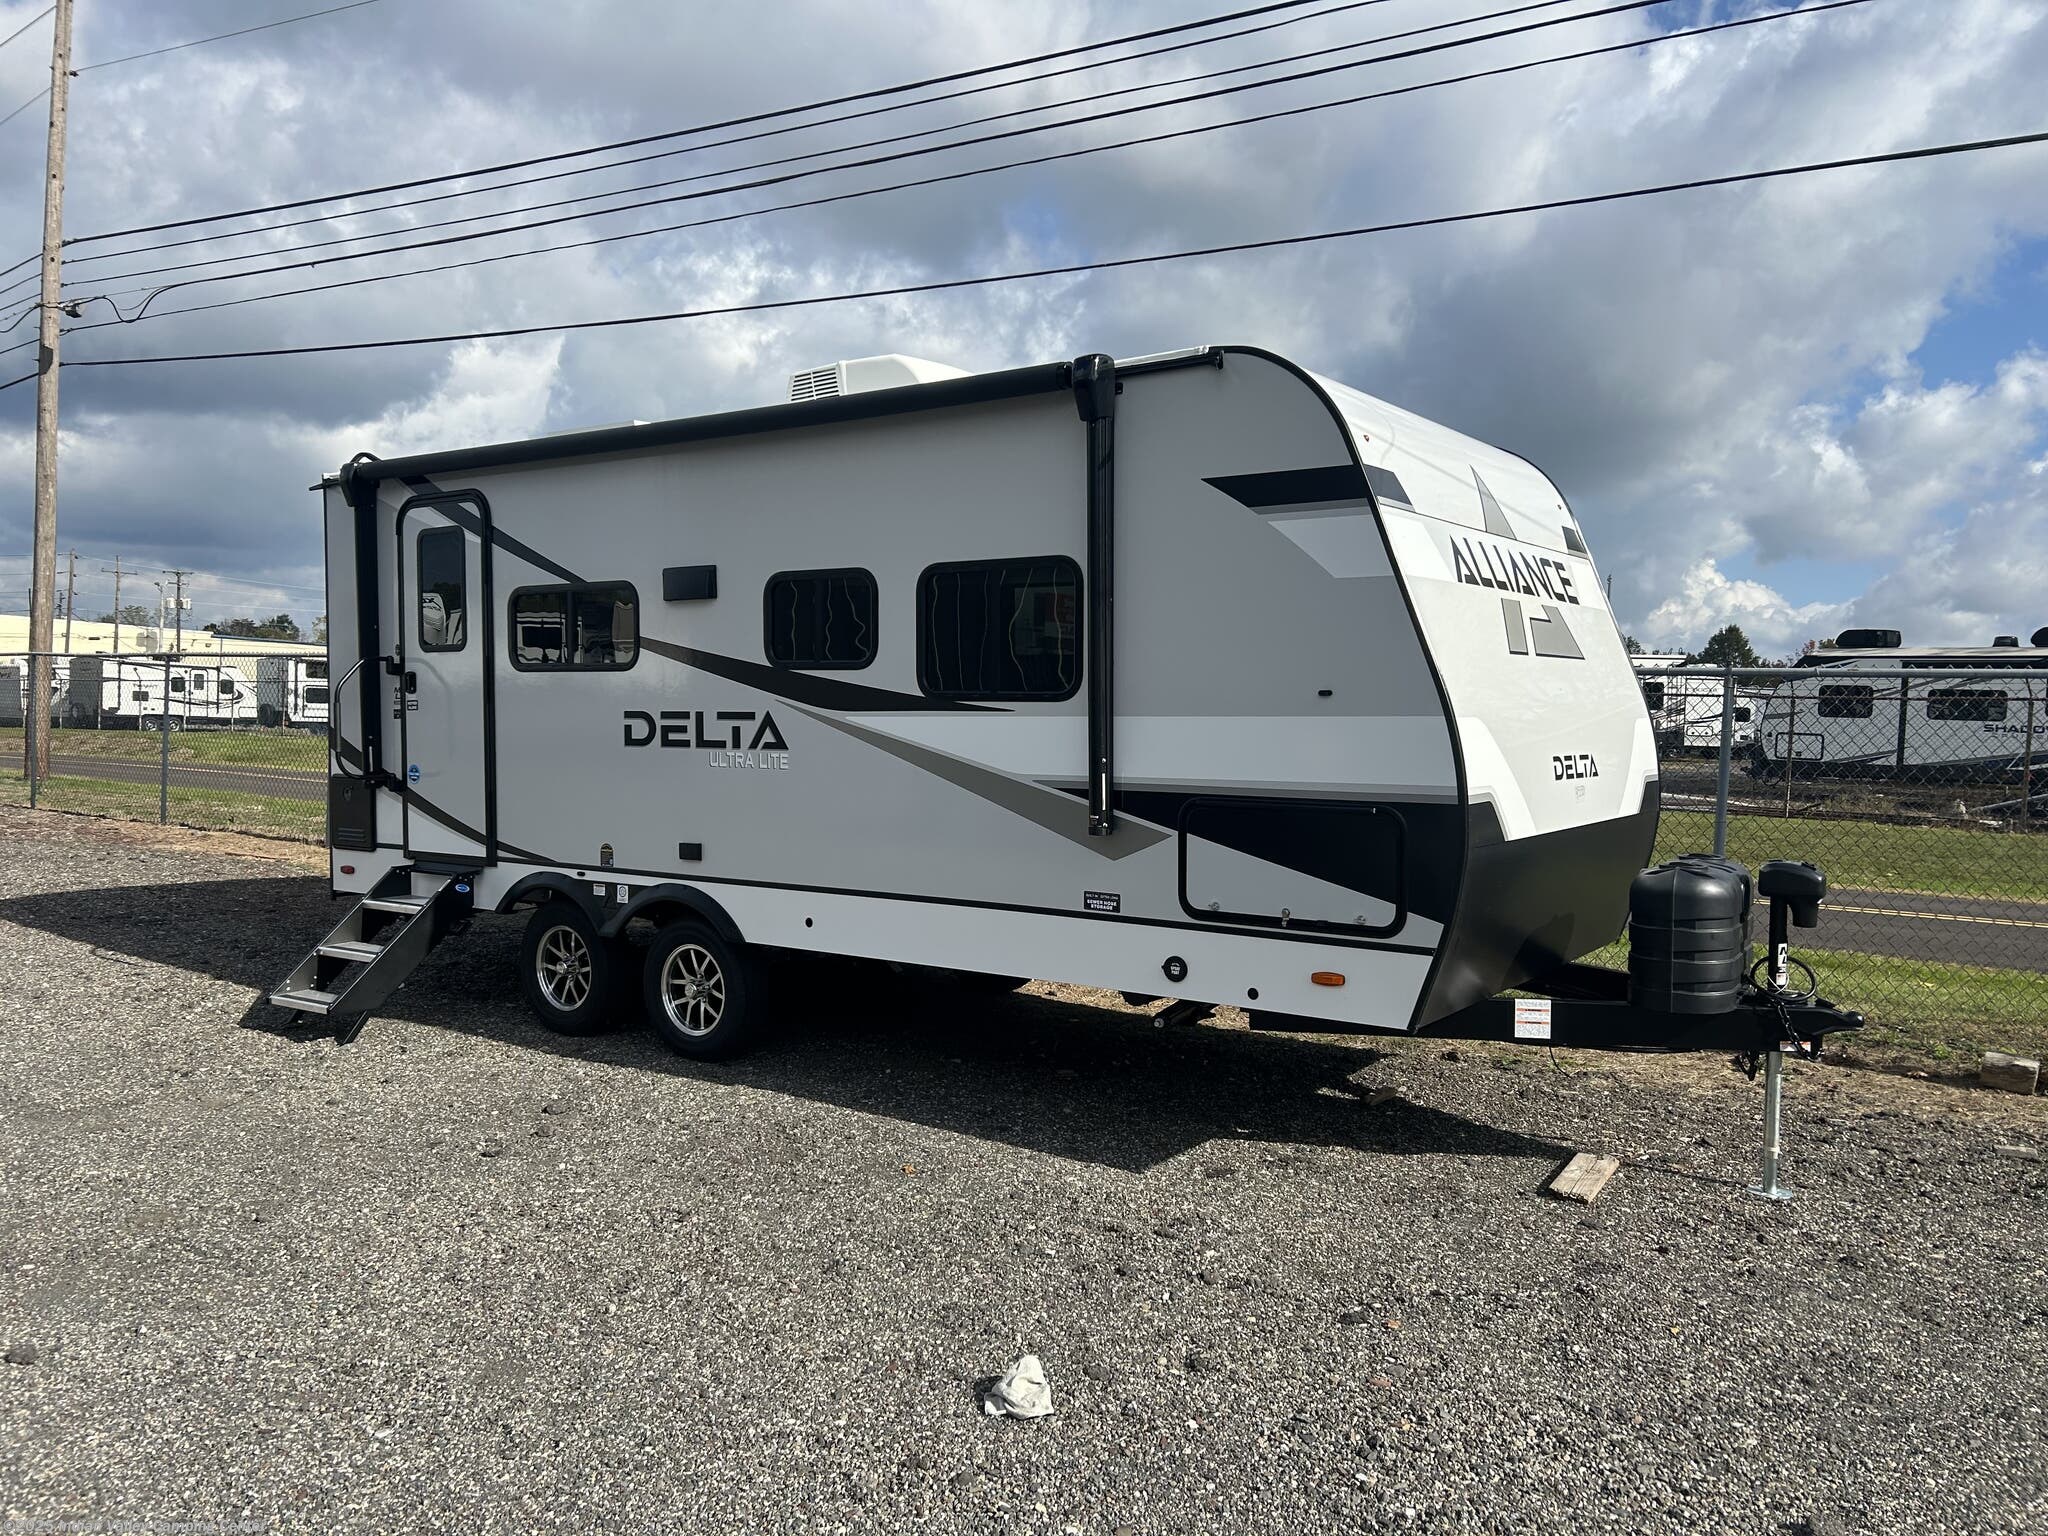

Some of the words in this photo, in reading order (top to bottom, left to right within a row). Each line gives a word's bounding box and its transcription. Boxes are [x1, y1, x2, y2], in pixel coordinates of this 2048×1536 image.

[1449, 534, 1580, 605] ALLIANCE
[624, 710, 789, 751] DELTA
[1984, 724, 2048, 734] SHADO
[709, 751, 754, 769] ULTRA
[758, 753, 790, 771] LITE
[1553, 753, 1599, 781] DELTA
